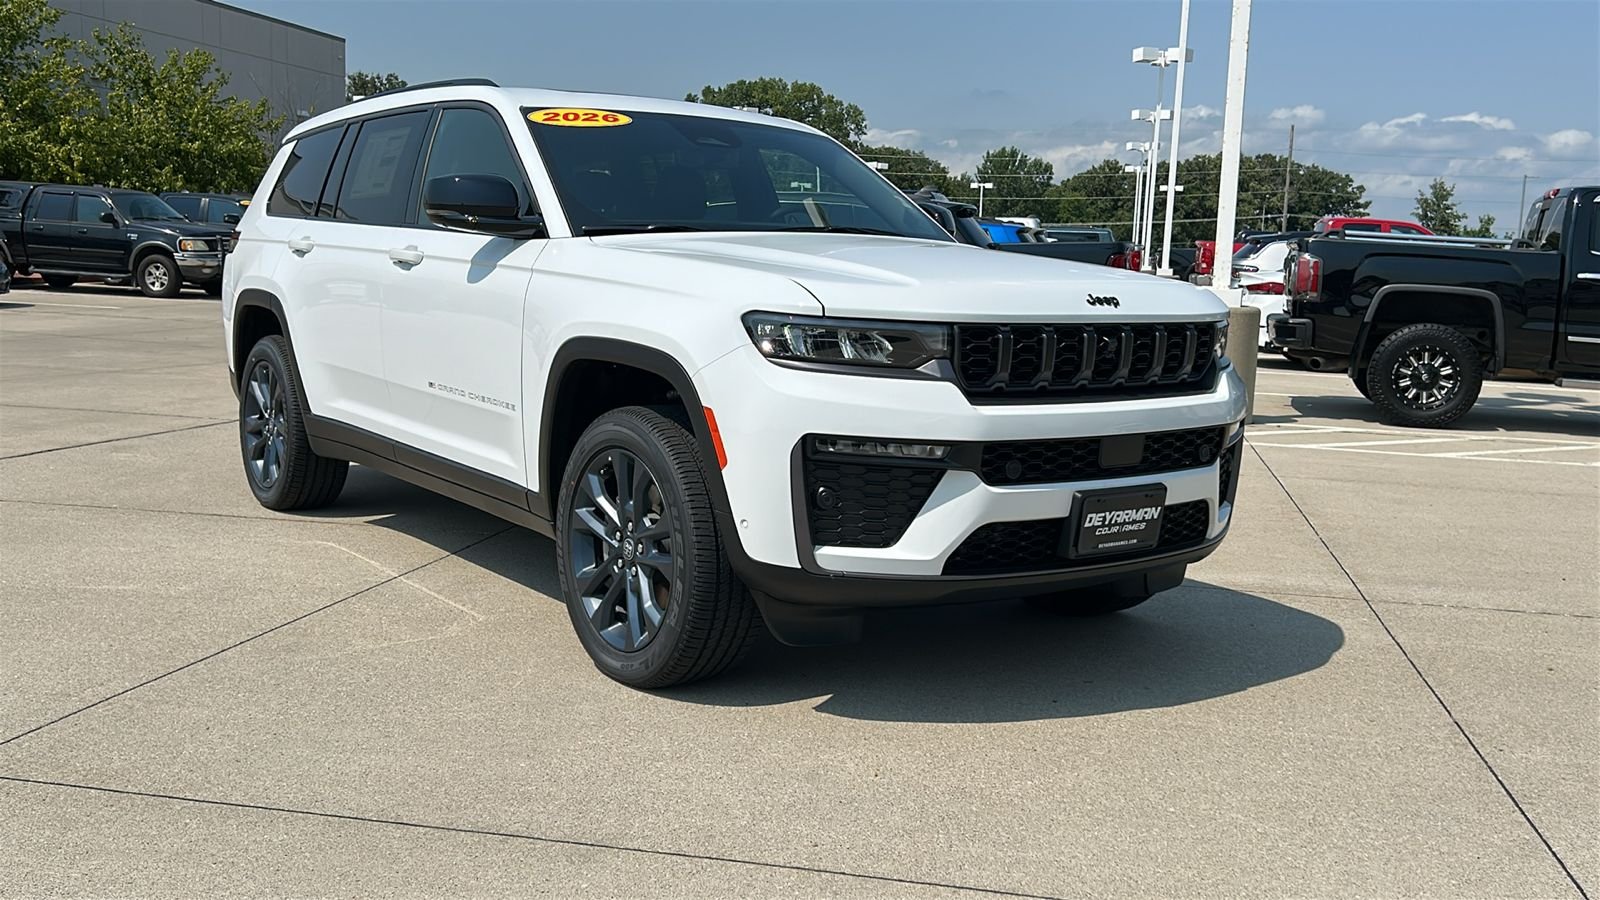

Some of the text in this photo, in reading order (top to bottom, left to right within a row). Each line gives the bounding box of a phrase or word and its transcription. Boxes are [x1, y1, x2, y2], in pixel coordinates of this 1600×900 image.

[542, 112, 620, 123] 2026
[1086, 293, 1120, 309] Jeep
[437, 383, 516, 412] GRAND CHEROKEE
[1084, 506, 1161, 528] DEYARMAN
[1122, 522, 1147, 532] AMES
